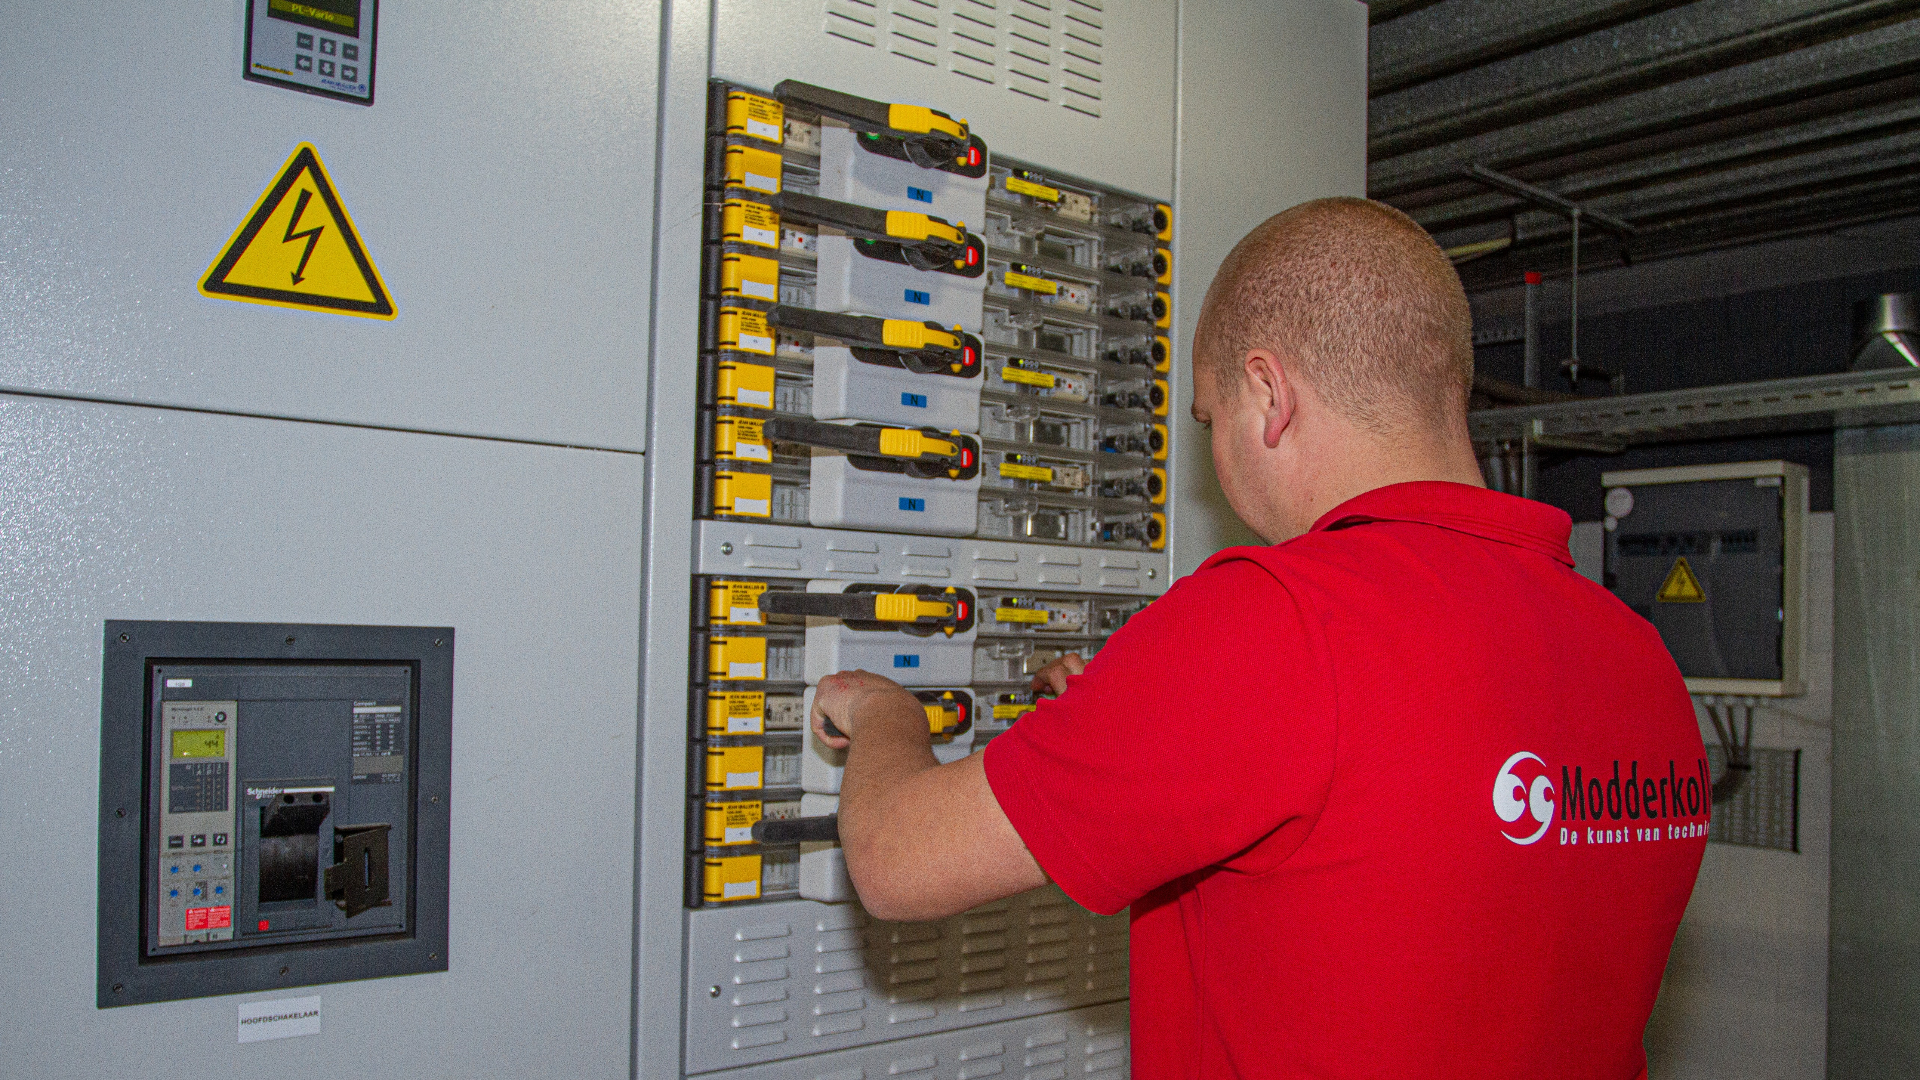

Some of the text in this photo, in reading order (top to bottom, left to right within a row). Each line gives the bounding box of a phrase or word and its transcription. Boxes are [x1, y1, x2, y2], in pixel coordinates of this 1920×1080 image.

[917, 190, 924, 200] N
[914, 292, 921, 302] N
[910, 395, 918, 405] N
[908, 500, 916, 510] N
[903, 656, 911, 666] N
[246, 786, 283, 798] Schneider
[1560, 827, 1578, 845] De
[1587, 826, 1629, 845] kunst
[1637, 827, 1660, 842] van
[240, 1010, 319, 1026] HOOFDSCHAKELAAR
